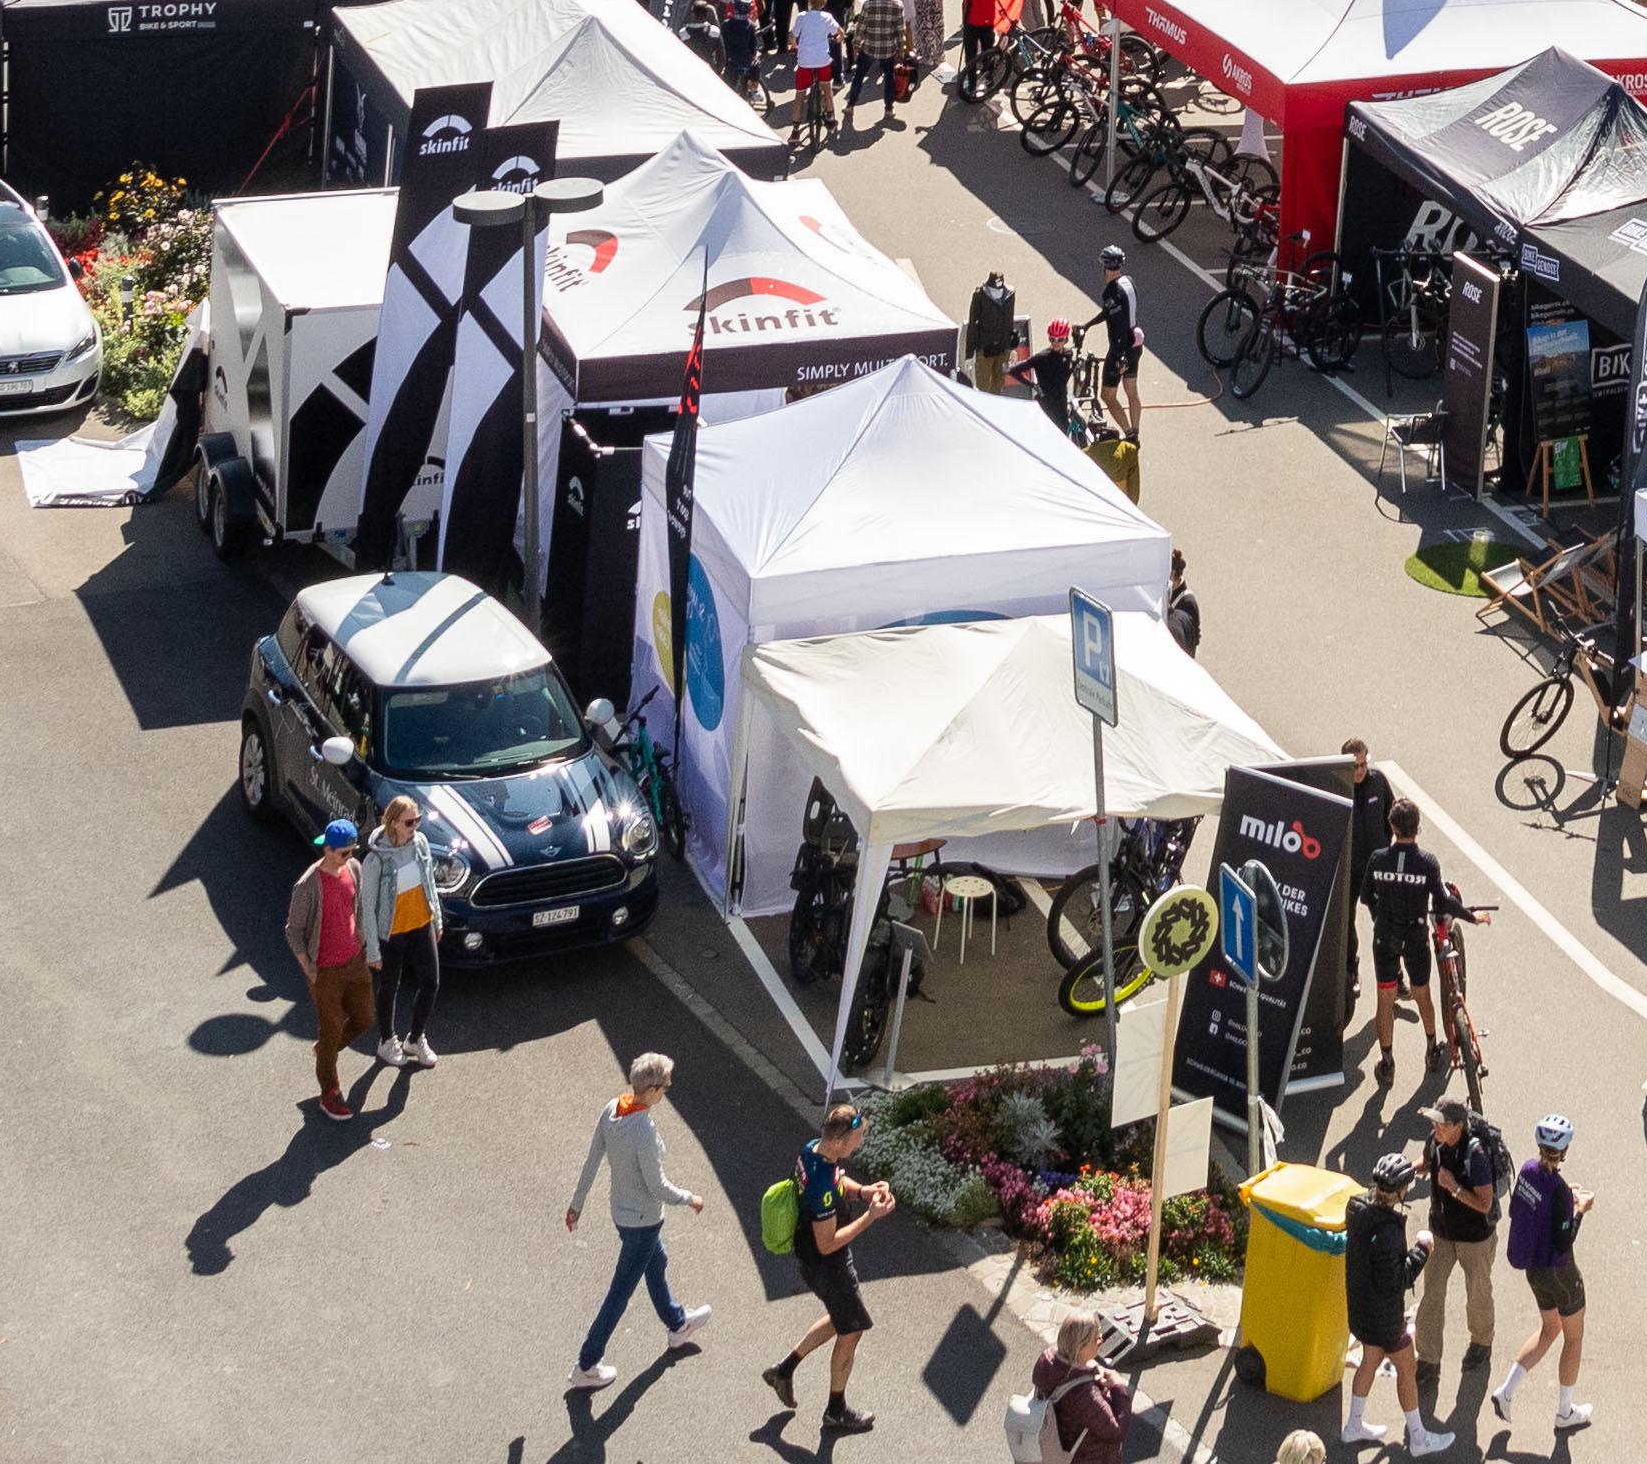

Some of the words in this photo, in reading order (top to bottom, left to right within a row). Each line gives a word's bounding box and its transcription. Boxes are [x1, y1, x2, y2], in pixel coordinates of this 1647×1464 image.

[139, 2, 217, 17] TROPHY
[139, 23, 159, 31] BIKE
[160, 22, 167, 30] &
[168, 20, 196, 29] SPORT
[1348, 115, 1368, 142] ROSE
[1475, 101, 1557, 152] ROSE
[419, 137, 470, 155] skinfit
[546, 243, 585, 293] kinfit
[1462, 281, 1482, 304] ROSE
[796, 360, 852, 382] SIMPLY
[1599, 352, 1631, 378] BIK
[1083, 609, 1102, 668] P
[1282, 883, 1306, 901] DER
